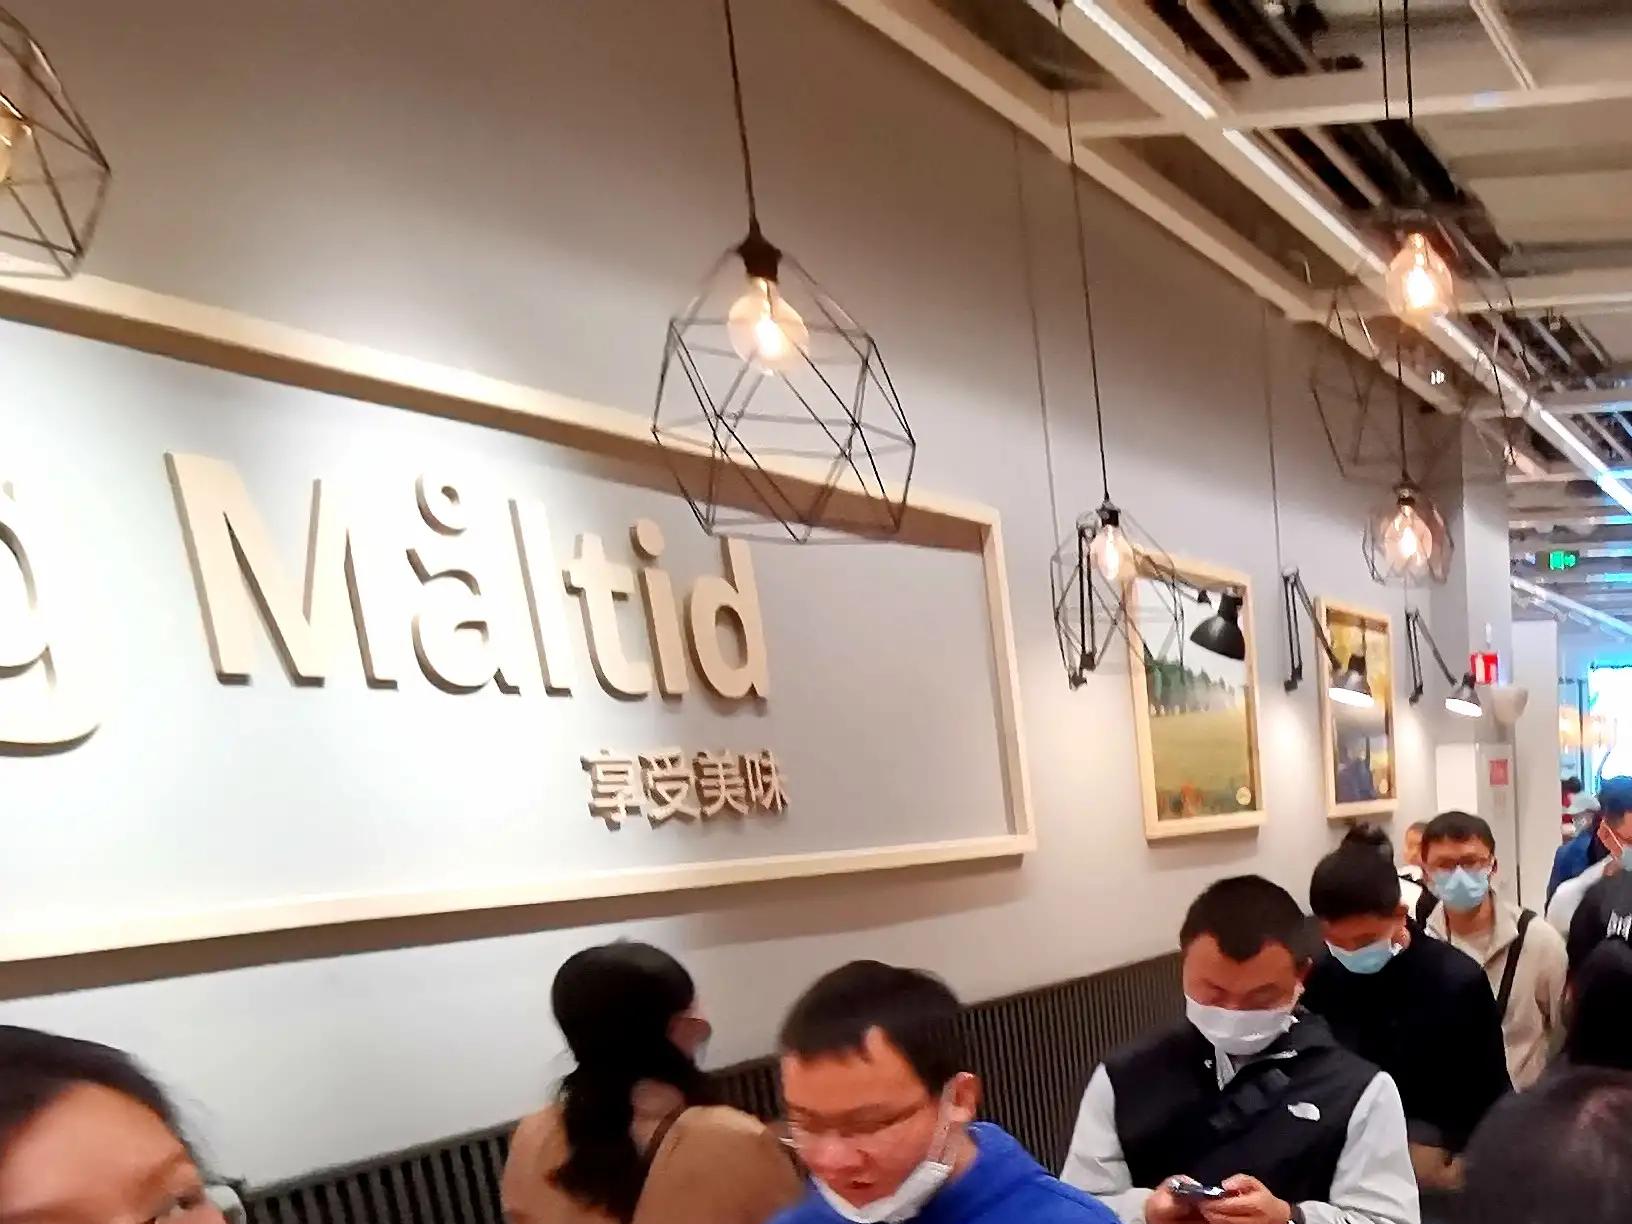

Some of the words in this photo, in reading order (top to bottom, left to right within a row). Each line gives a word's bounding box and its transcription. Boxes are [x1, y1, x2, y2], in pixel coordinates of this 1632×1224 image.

[163, 451, 770, 716] Måltid
[580, 748, 789, 831] 享受美味
